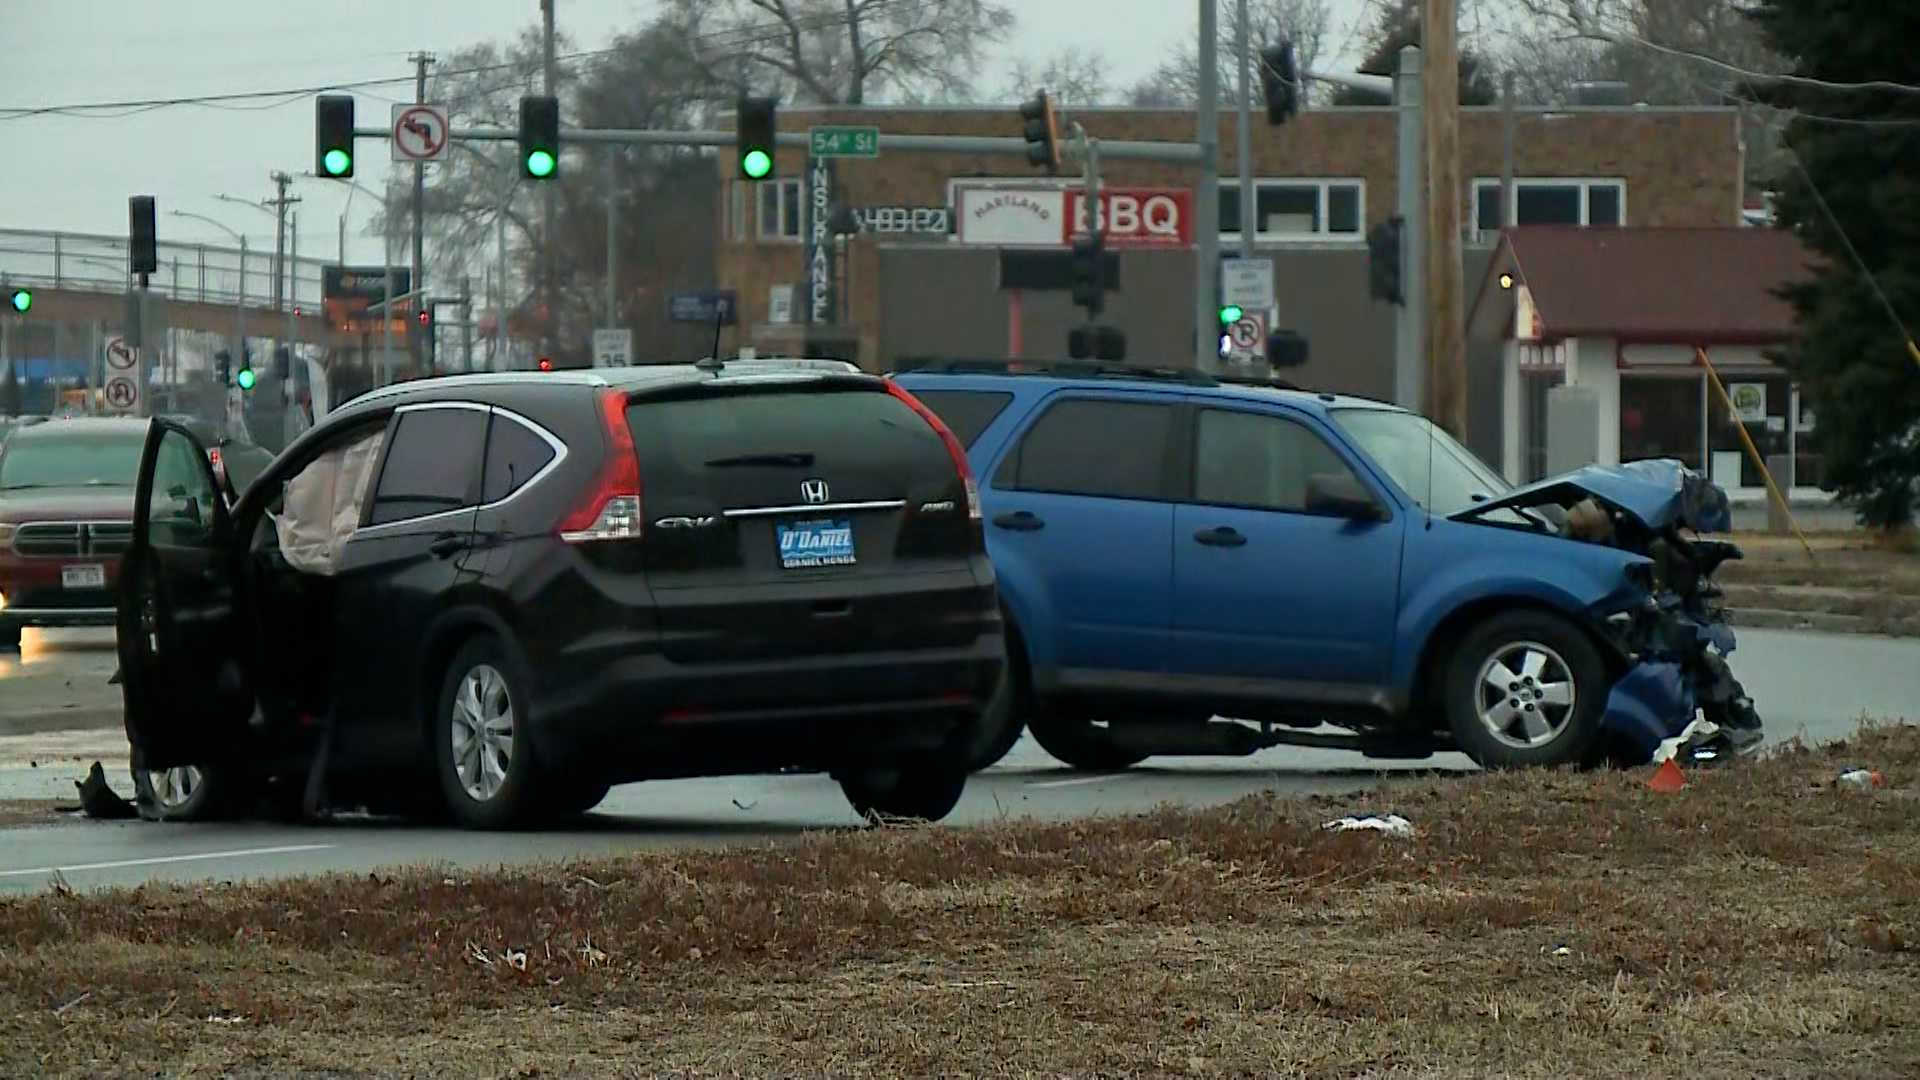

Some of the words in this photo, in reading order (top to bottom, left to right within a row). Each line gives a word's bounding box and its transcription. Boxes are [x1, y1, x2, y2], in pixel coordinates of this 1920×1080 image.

[1074, 195, 1178, 235] BBQ
[812, 156, 828, 323] INSURANCE
[780, 528, 851, 550] O'DANIEL
